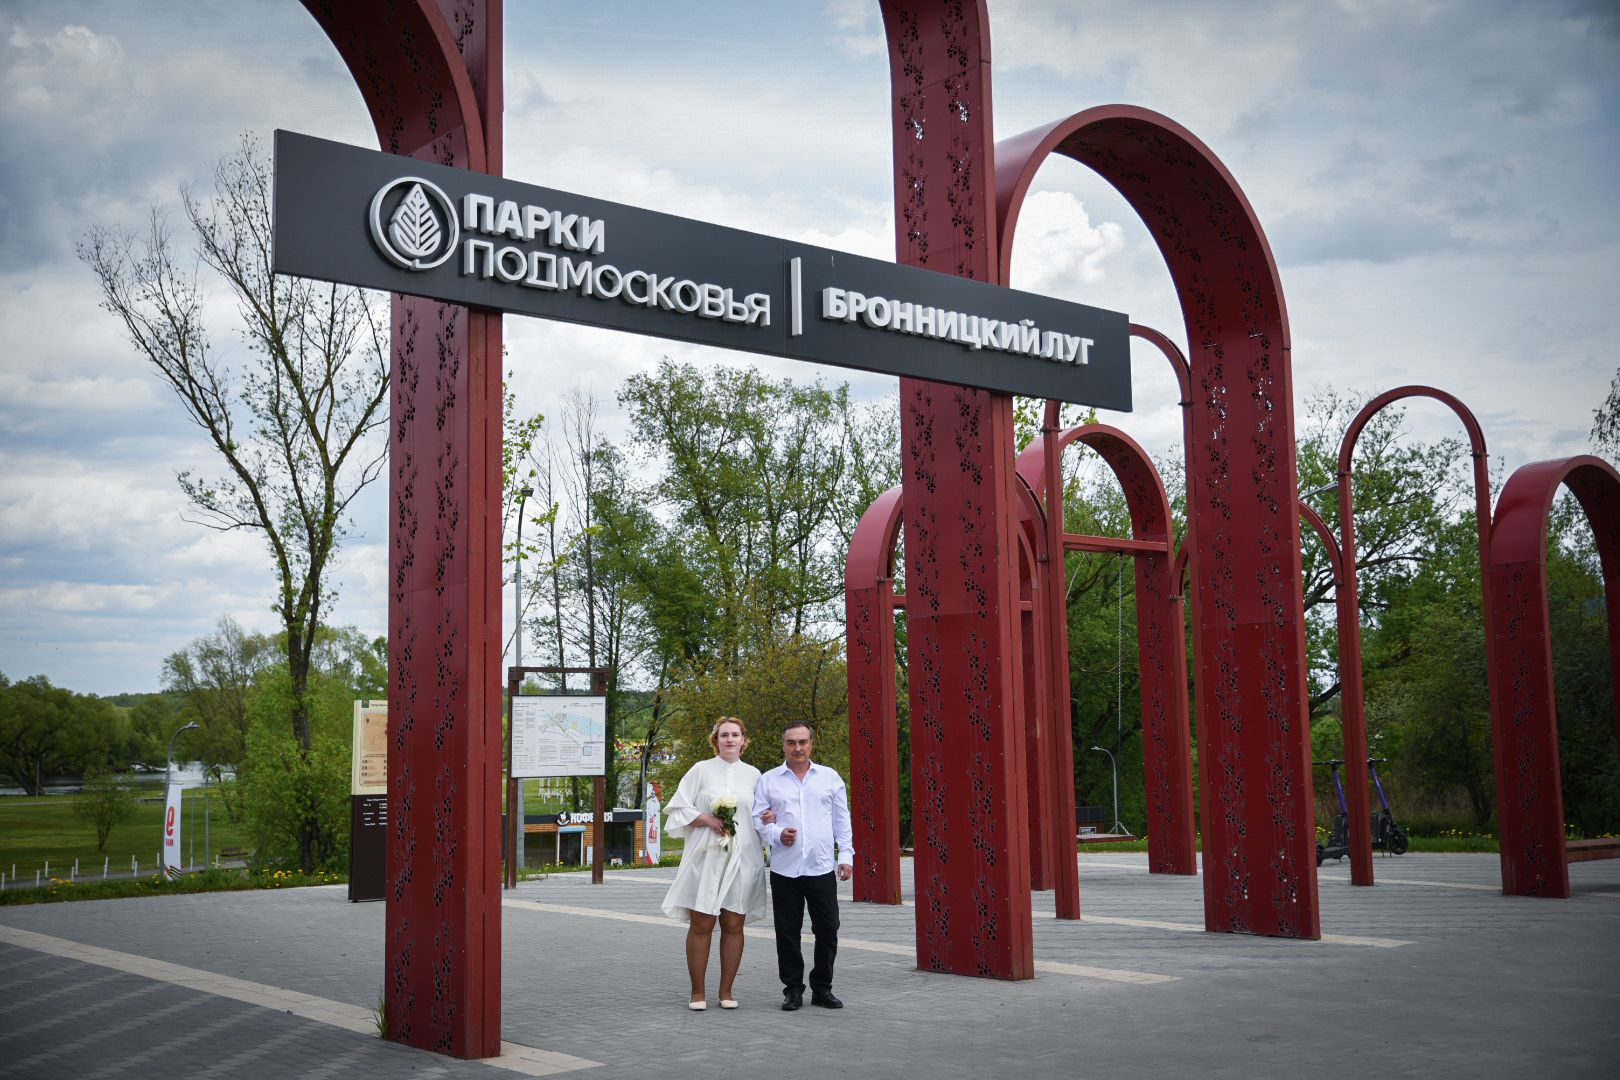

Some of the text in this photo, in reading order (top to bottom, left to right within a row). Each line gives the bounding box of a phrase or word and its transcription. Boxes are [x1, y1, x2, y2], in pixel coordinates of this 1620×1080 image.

[463, 193, 604, 255] ПАРКИ
[463, 239, 771, 326] ПОДМОСКОВЬЯ
[822, 287, 1094, 365] БРОННИЦКИЙ ЛУГ
